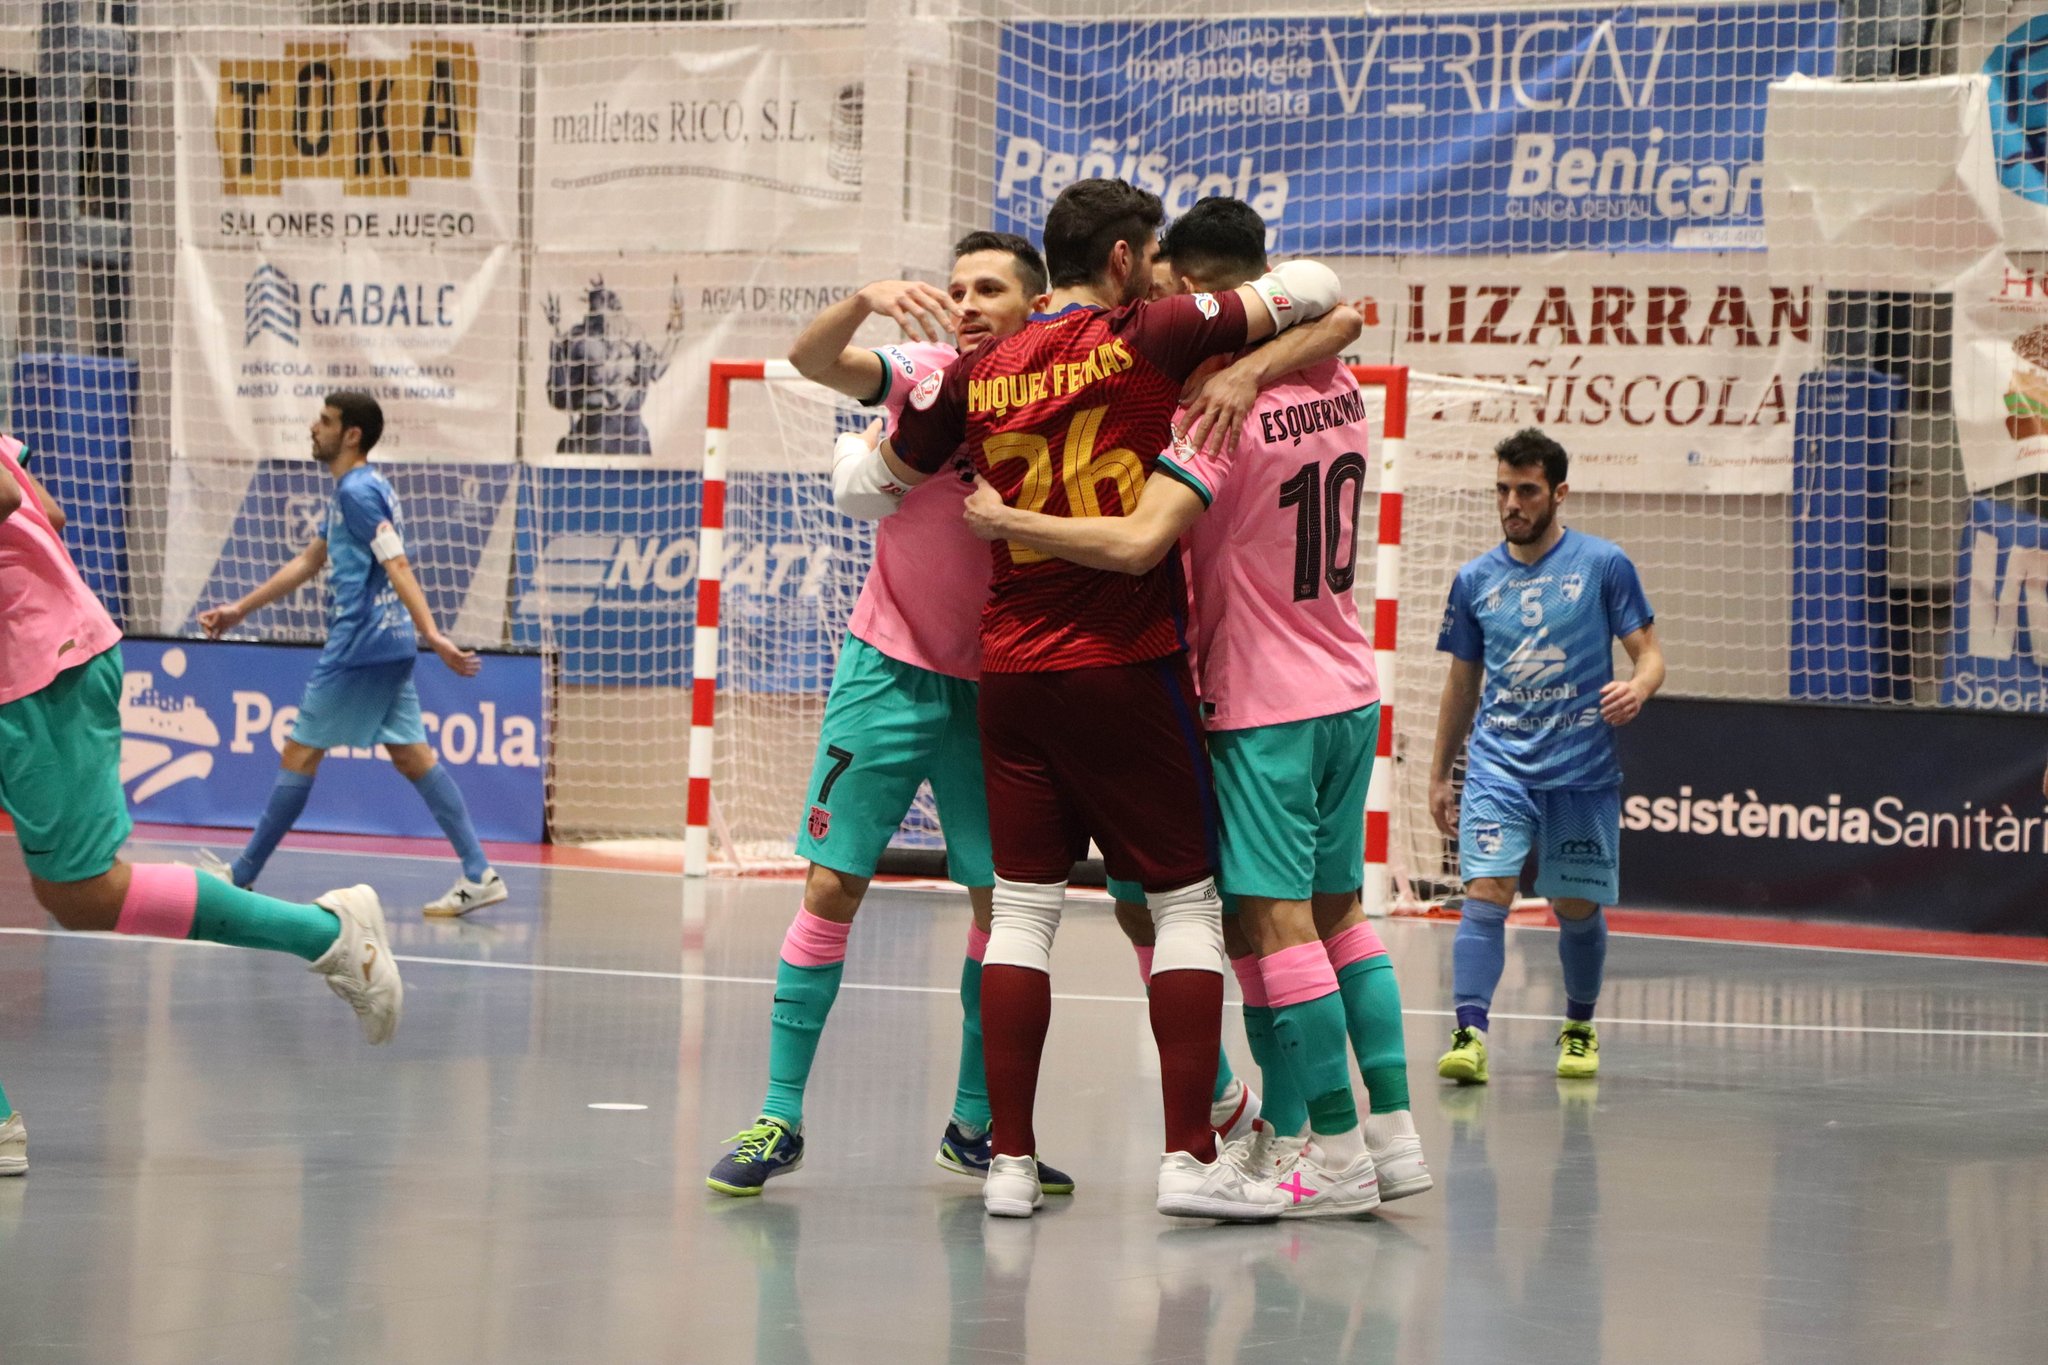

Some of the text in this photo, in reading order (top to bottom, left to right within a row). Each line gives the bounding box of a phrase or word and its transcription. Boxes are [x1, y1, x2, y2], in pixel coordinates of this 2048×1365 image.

[1203, 26, 1313, 48] UNIDAD DE
[1125, 50, 1313, 86] Implantología
[1320, 16, 1698, 115] VERICAT
[230, 60, 463, 177] TOKA
[670, 99, 750, 147] RICO,
[760, 99, 816, 143] S.L.
[1171, 88, 1311, 117] Inmediata
[219, 211, 475, 238] SALONES DE JUEGO
[1406, 283, 1814, 346] LIZARRAN
[968, 370, 1049, 418] MIQUEL
[982, 404, 1147, 565] 26
[1278, 452, 1367, 603] 10
[1520, 587, 1543, 627] 5
[817, 744, 855, 804] 7
